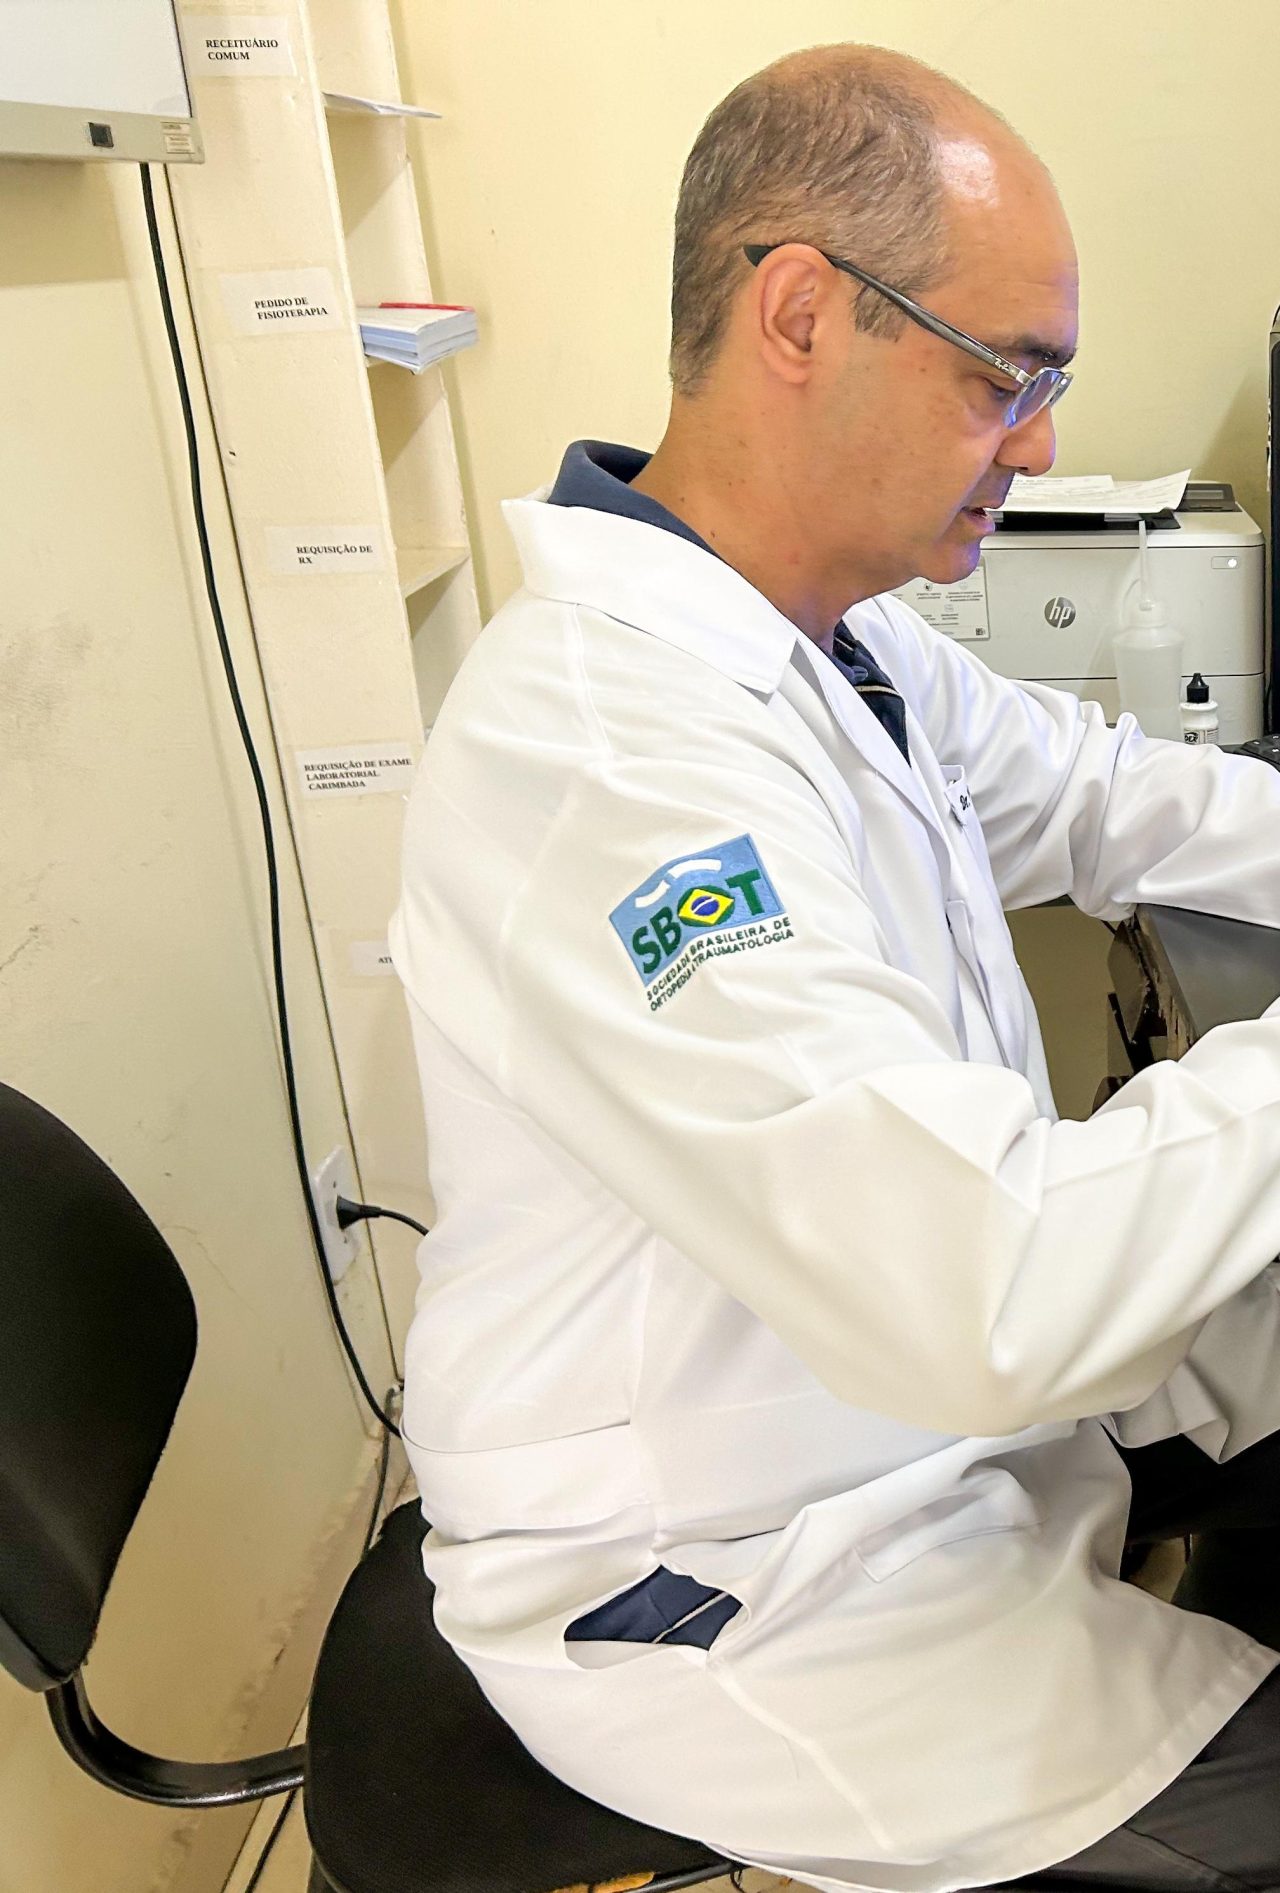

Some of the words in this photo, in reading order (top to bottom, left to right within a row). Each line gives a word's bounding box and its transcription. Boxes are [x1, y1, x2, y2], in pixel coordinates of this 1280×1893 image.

[206, 37, 279, 48] RECEITUÁRIO
[208, 51, 250, 60] COMUM
[254, 298, 293, 309] PEDIDO
[295, 297, 309, 306] DE
[257, 307, 328, 320] FISIOTERAPIA
[296, 544, 357, 555] REQUISIÇÃO
[359, 545, 373, 553] DE
[298, 556, 313, 564] RX
[1046, 597, 1075, 629] hp
[304, 760, 363, 772] REQUISIÇÃO
[364, 760, 377, 768] DE
[378, 758, 412, 768] EXAME
[306, 770, 380, 782] LABORATORIAL
[308, 780, 366, 791] CARIMBADA
[632, 868, 766, 975] SBOT
[646, 951, 690, 1001] SOCIEDADE
[689, 925, 767, 957] BRASILEIRA
[773, 917, 792, 929] DE
[650, 966, 691, 1012] ORTOPEDIA
[693, 929, 795, 970] TRAUMATOLOGIA
